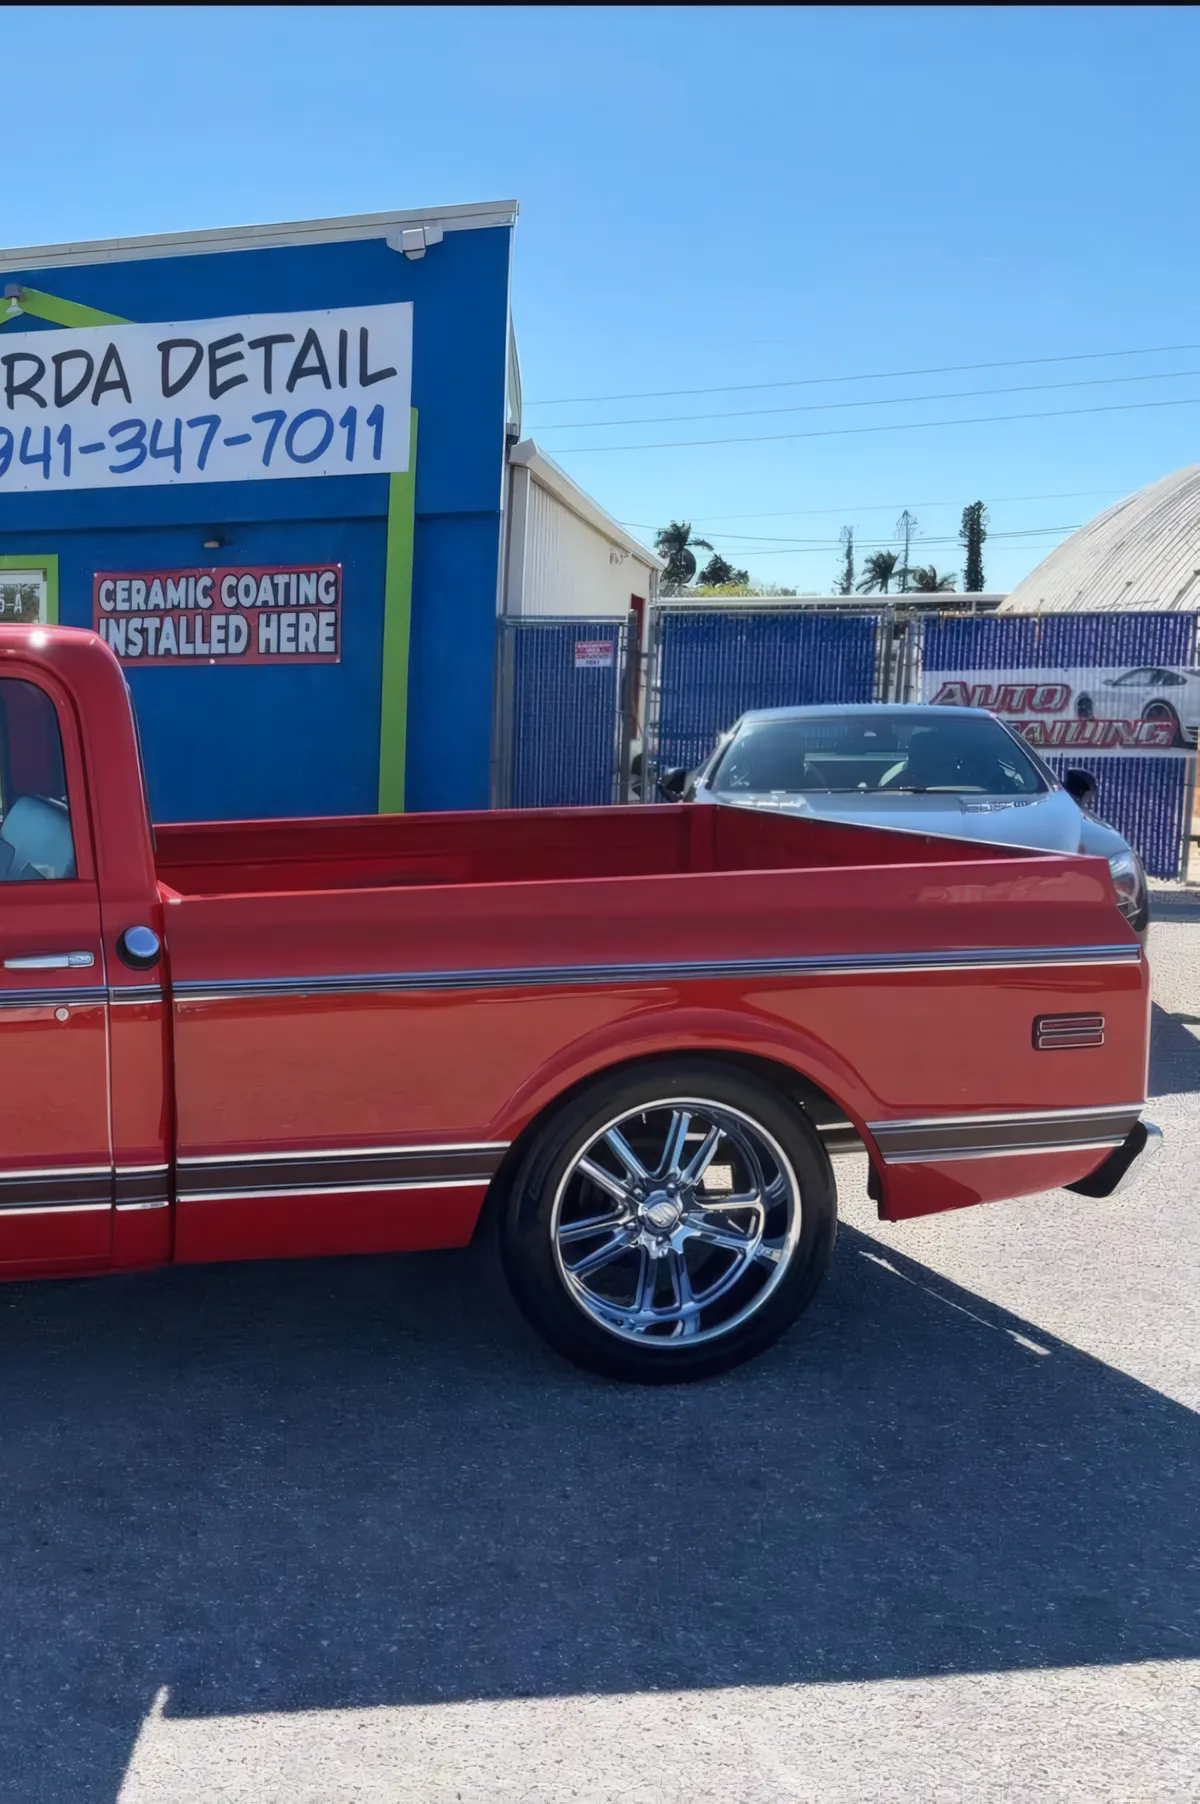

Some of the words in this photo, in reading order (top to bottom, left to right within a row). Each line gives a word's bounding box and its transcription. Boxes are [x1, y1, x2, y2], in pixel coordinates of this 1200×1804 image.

[156, 326, 398, 400] DETAIL
[98, 574, 215, 613] CERAMIC
[219, 570, 337, 609] COATING
[98, 613, 249, 657] INSTALLED
[258, 611, 336, 653] HERE
[930, 681, 1071, 713] AUTO
[1005, 719, 1178, 748] AILING
